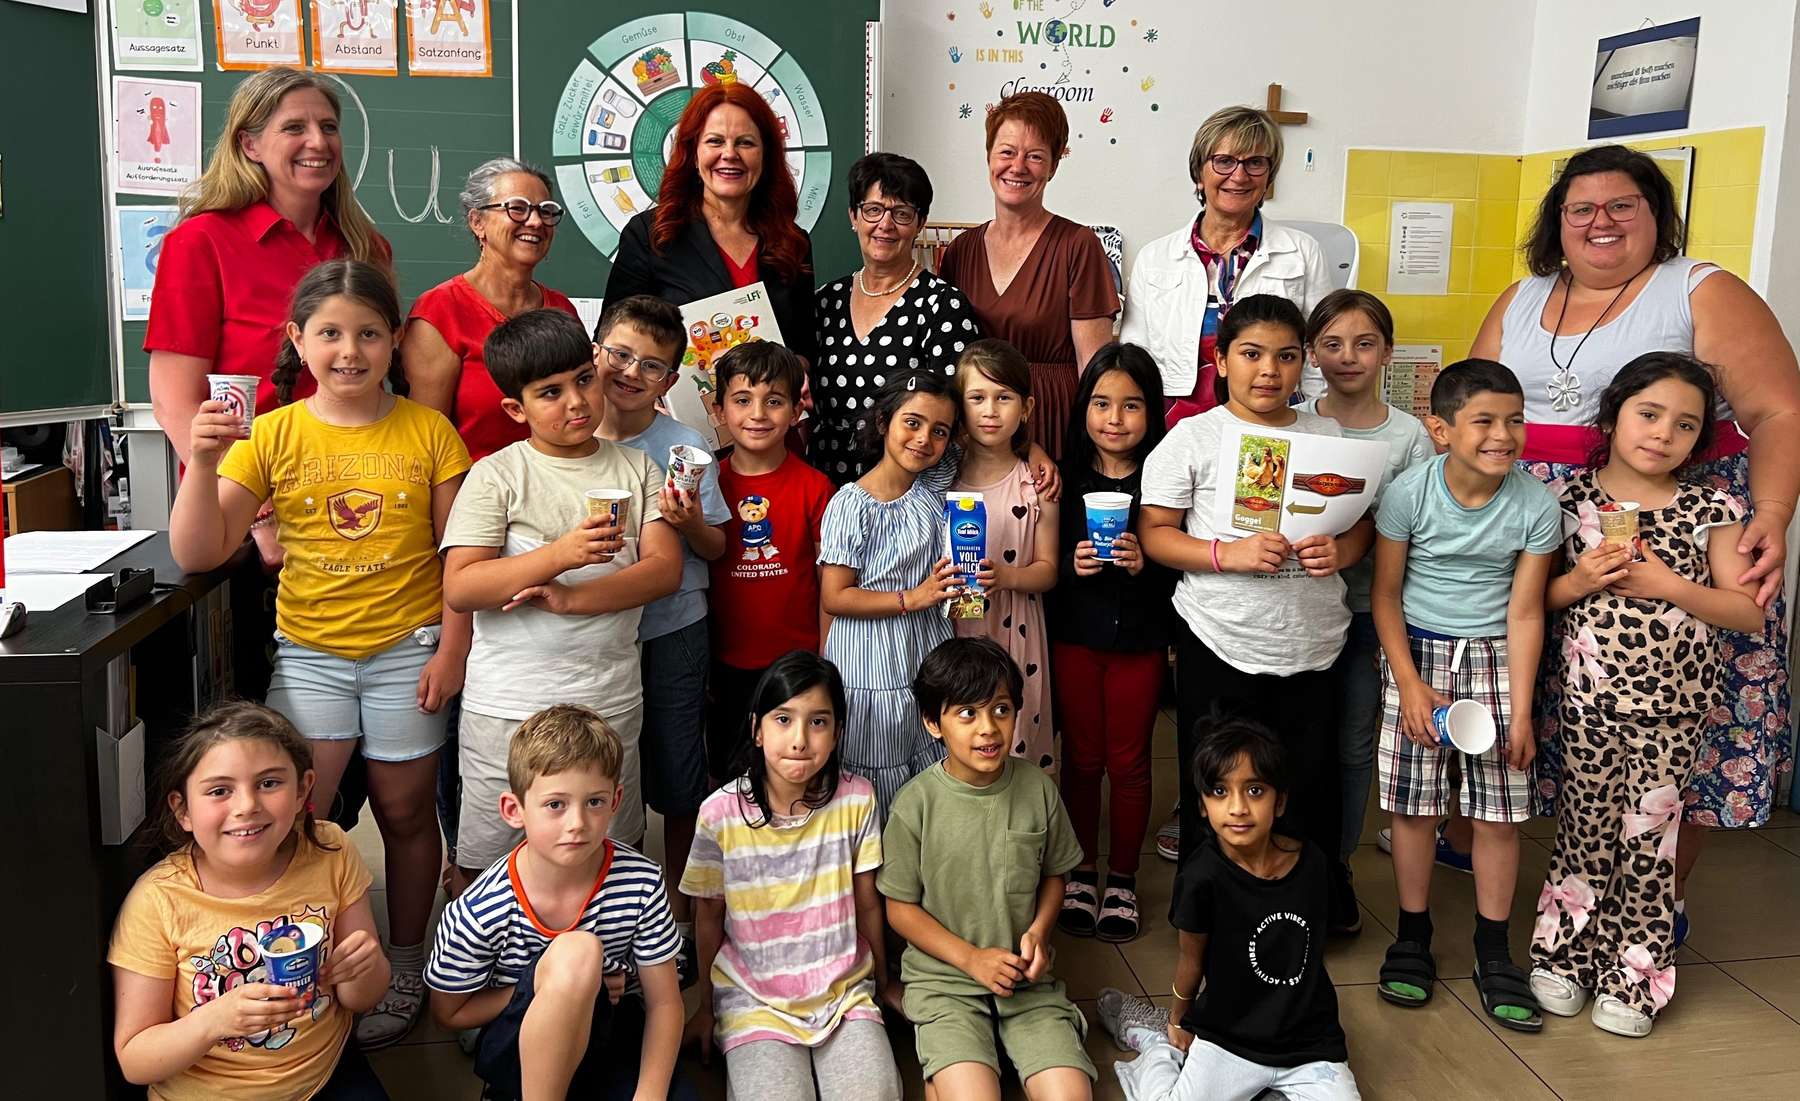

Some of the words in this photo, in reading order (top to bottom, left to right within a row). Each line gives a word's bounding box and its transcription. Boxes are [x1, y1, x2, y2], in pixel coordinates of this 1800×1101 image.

[621, 25, 658, 45] Gemüse
[725, 27, 746, 43] Obst
[129, 43, 186, 53] Aussagesatz
[246, 38, 279, 49] Punkt
[335, 44, 382, 55] Abstand
[418, 46, 482, 60] Satzanfang
[976, 49, 985, 61] IS
[988, 49, 999, 62] IN
[1002, 50, 1024, 63] THIS
[793, 83, 815, 119] Wasser
[281, 452, 426, 494] ARIZONA
[959, 551, 979, 563] VOLL
[322, 563, 351, 573] EAGLE
[354, 562, 387, 573] STATE
[736, 562, 782, 571] COLORADO
[759, 568, 789, 578] STATES
[1256, 912, 1283, 934] ACTIVE
[1284, 911, 1307, 928] VIBES
